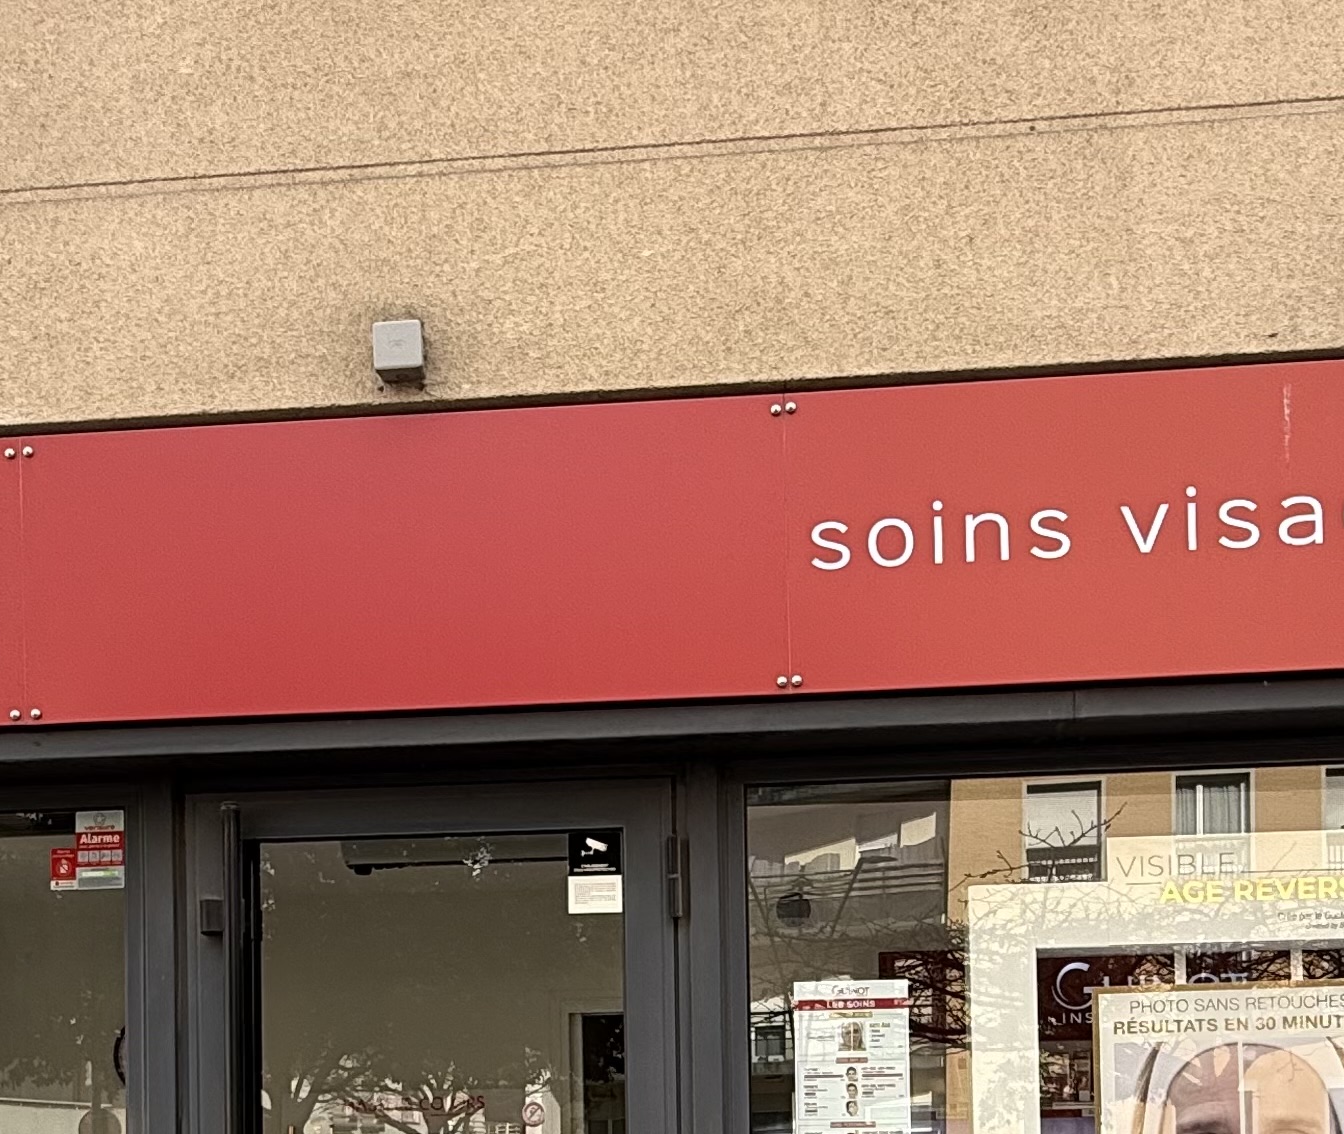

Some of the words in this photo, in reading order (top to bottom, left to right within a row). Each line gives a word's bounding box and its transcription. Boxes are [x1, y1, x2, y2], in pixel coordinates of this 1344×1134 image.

[811, 500, 1071, 570] soins
[80, 833, 120, 844] Alarme
[1116, 852, 1234, 877] VISIBLE
[1161, 880, 1224, 903] AGE
[1129, 998, 1189, 1014] PHOTO
[1194, 997, 1241, 1012] SANS
[1113, 1016, 1218, 1035] RÉSULTATS
[1225, 1018, 1249, 1032] EN
[1255, 1017, 1277, 1031] 30
